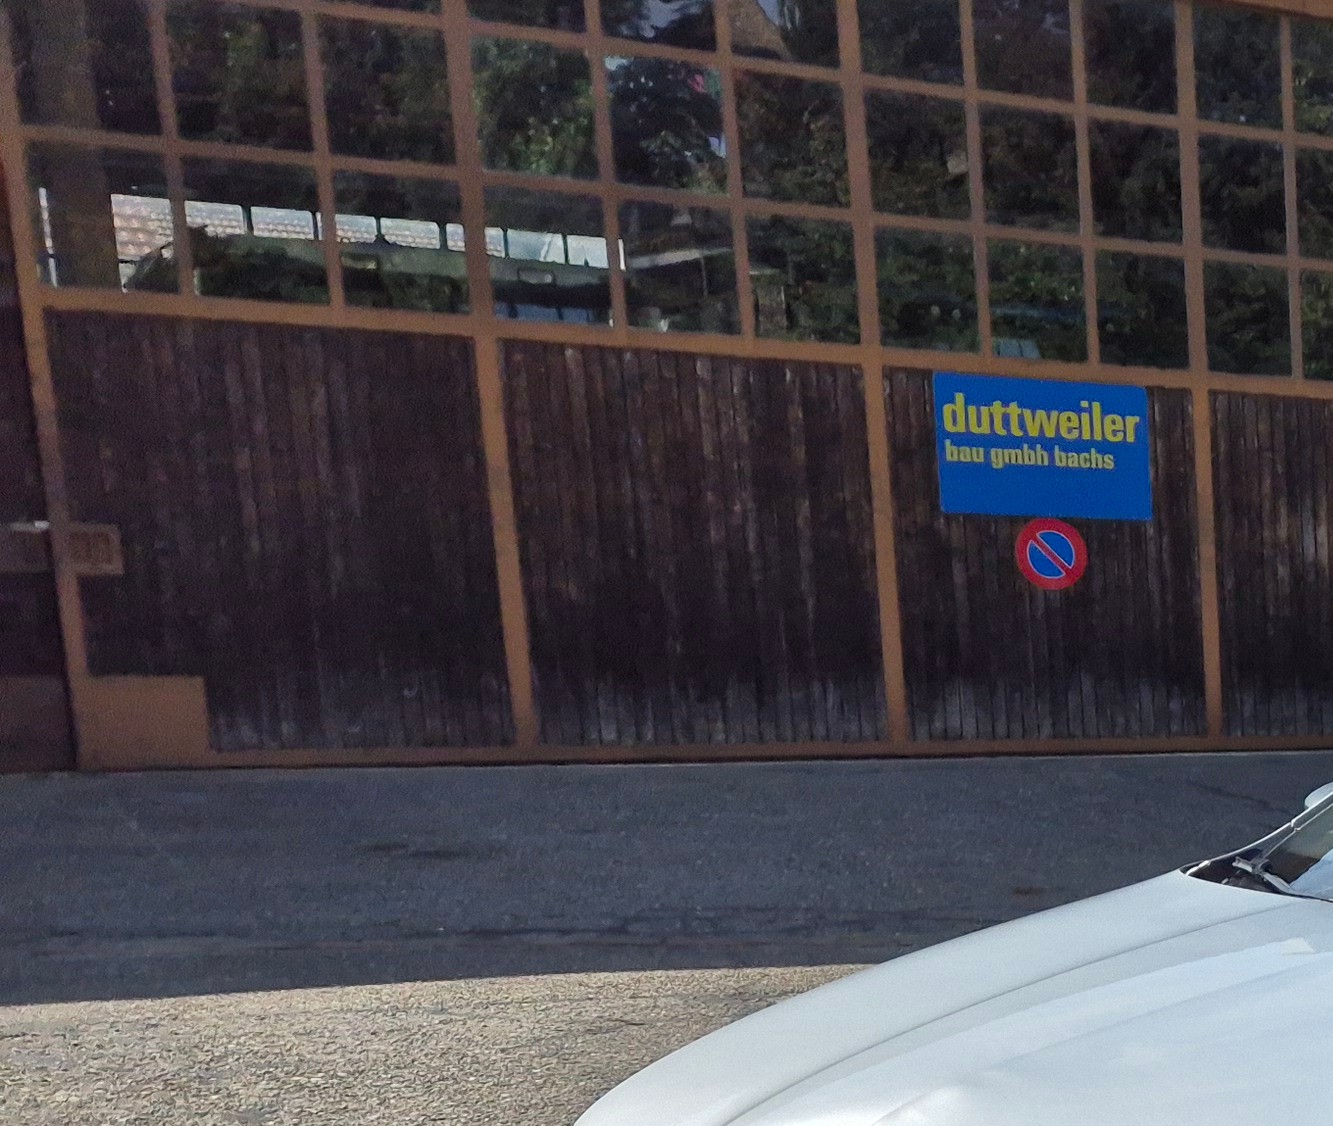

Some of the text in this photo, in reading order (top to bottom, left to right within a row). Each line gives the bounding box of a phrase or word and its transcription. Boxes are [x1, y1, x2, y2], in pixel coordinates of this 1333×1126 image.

[943, 393, 1139, 442] duttweiler
[945, 440, 1115, 470] bau gmbh bachs
